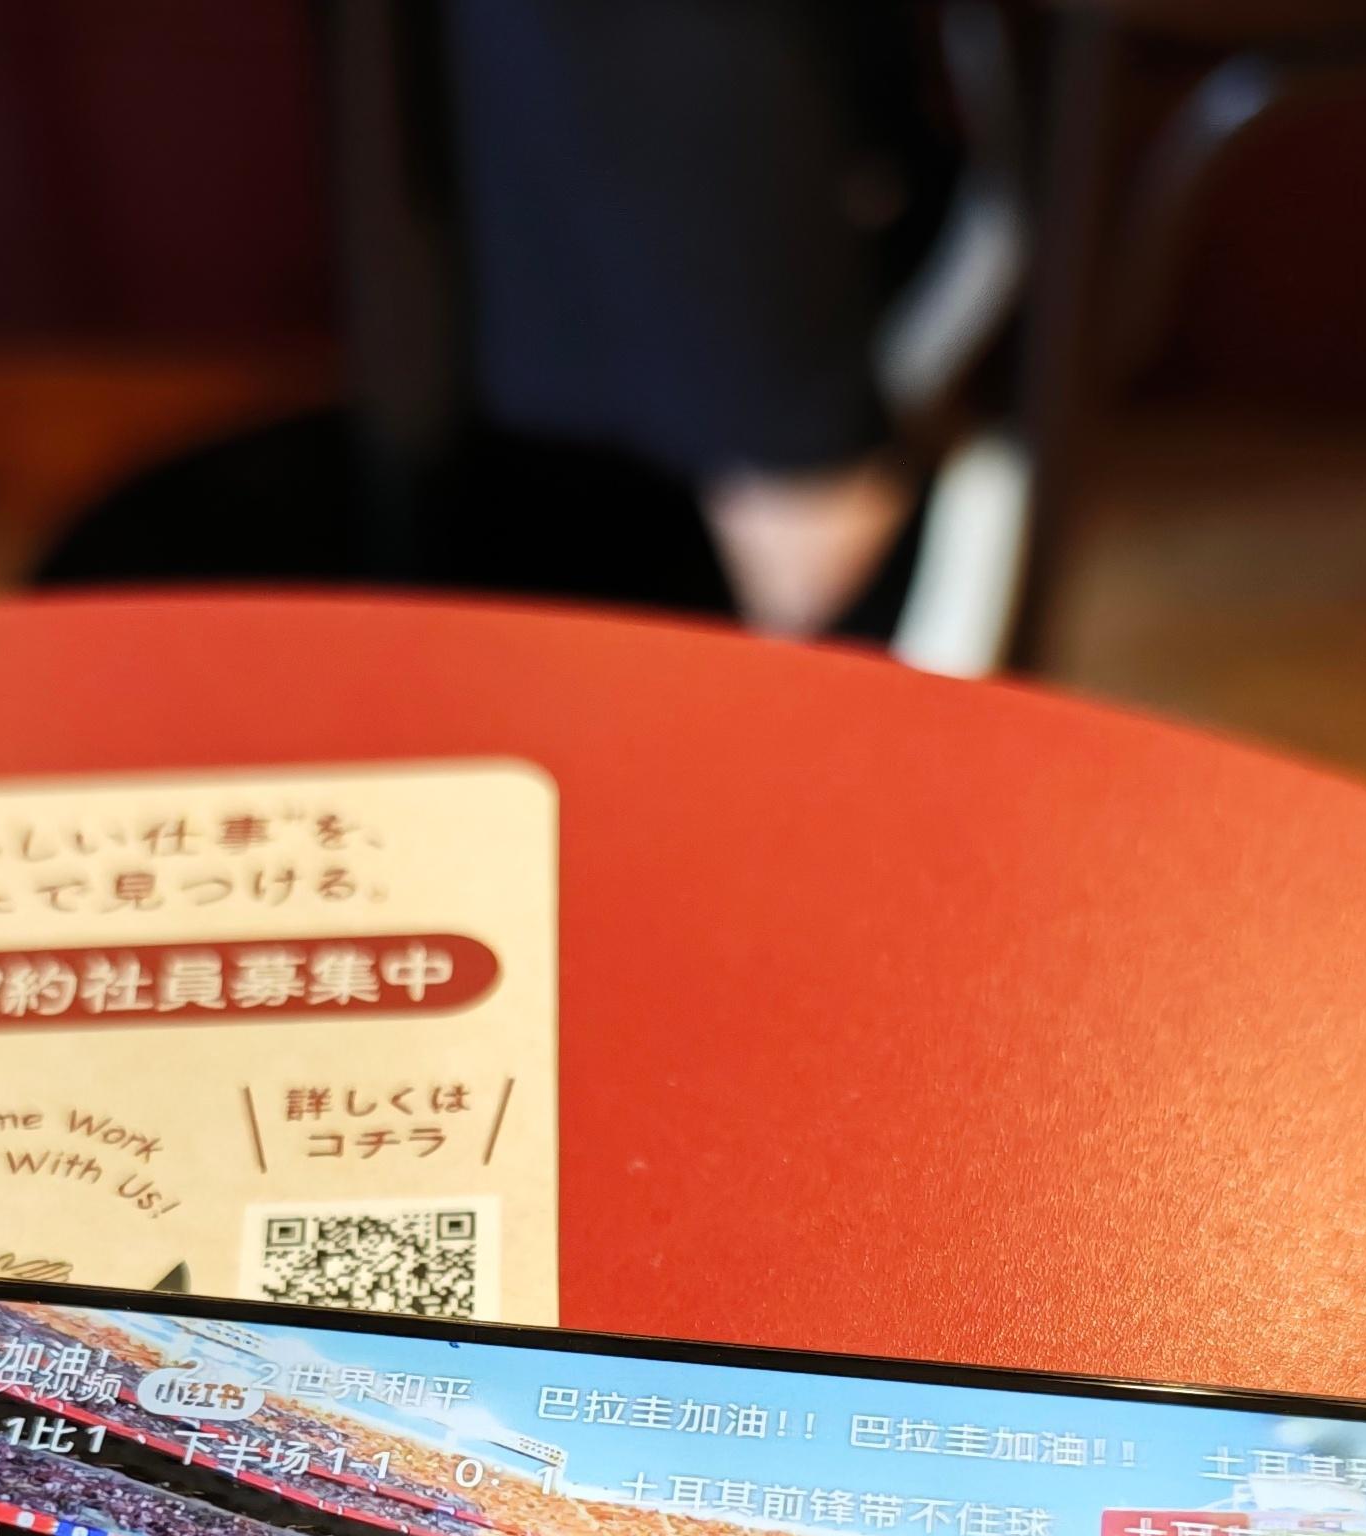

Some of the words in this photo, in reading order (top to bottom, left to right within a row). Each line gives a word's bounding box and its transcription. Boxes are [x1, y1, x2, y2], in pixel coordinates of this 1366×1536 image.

[285, 1083, 471, 1121] 詳しくは
[67, 1109, 163, 1163] Work
[307, 1127, 447, 1159] コチラ
[6, 1149, 102, 1184] With
[117, 1173, 181, 1218] Us!
